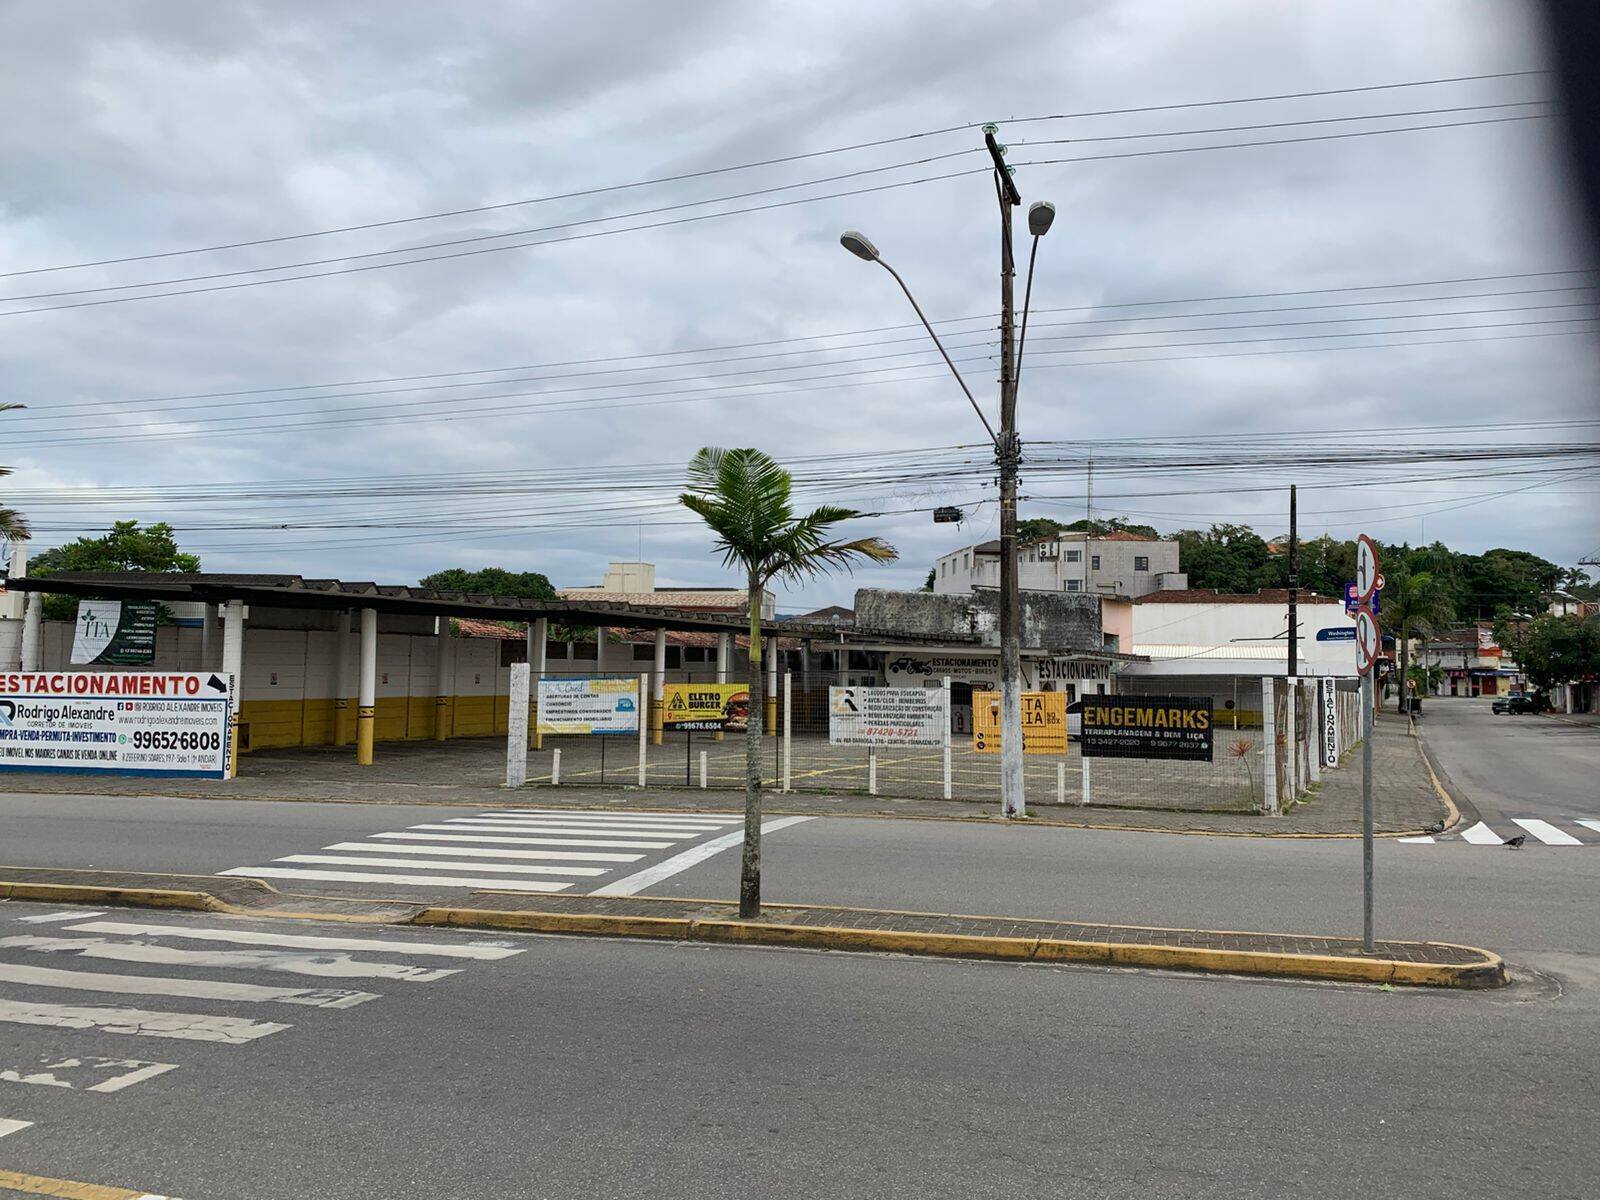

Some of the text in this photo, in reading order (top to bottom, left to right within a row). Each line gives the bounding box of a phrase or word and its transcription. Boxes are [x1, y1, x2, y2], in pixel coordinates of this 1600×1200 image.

[932, 658, 998, 667] ESTACIONAMENTO
[1039, 660, 1109, 680] ESTACIONAMENTO
[0, 674, 200, 695] ESTACIONAMENTO
[688, 693, 720, 701] ELETRO
[688, 701, 721, 709] BURGER
[17, 704, 115, 721] Rodrigo Alexandre
[1084, 706, 1210, 729] ENGEMARKS
[58, 721, 66, 729] DE
[1325, 680, 1336, 764] ESTACIONAMENTO
[1085, 728, 1153, 738] TERRAPLANAGEM
